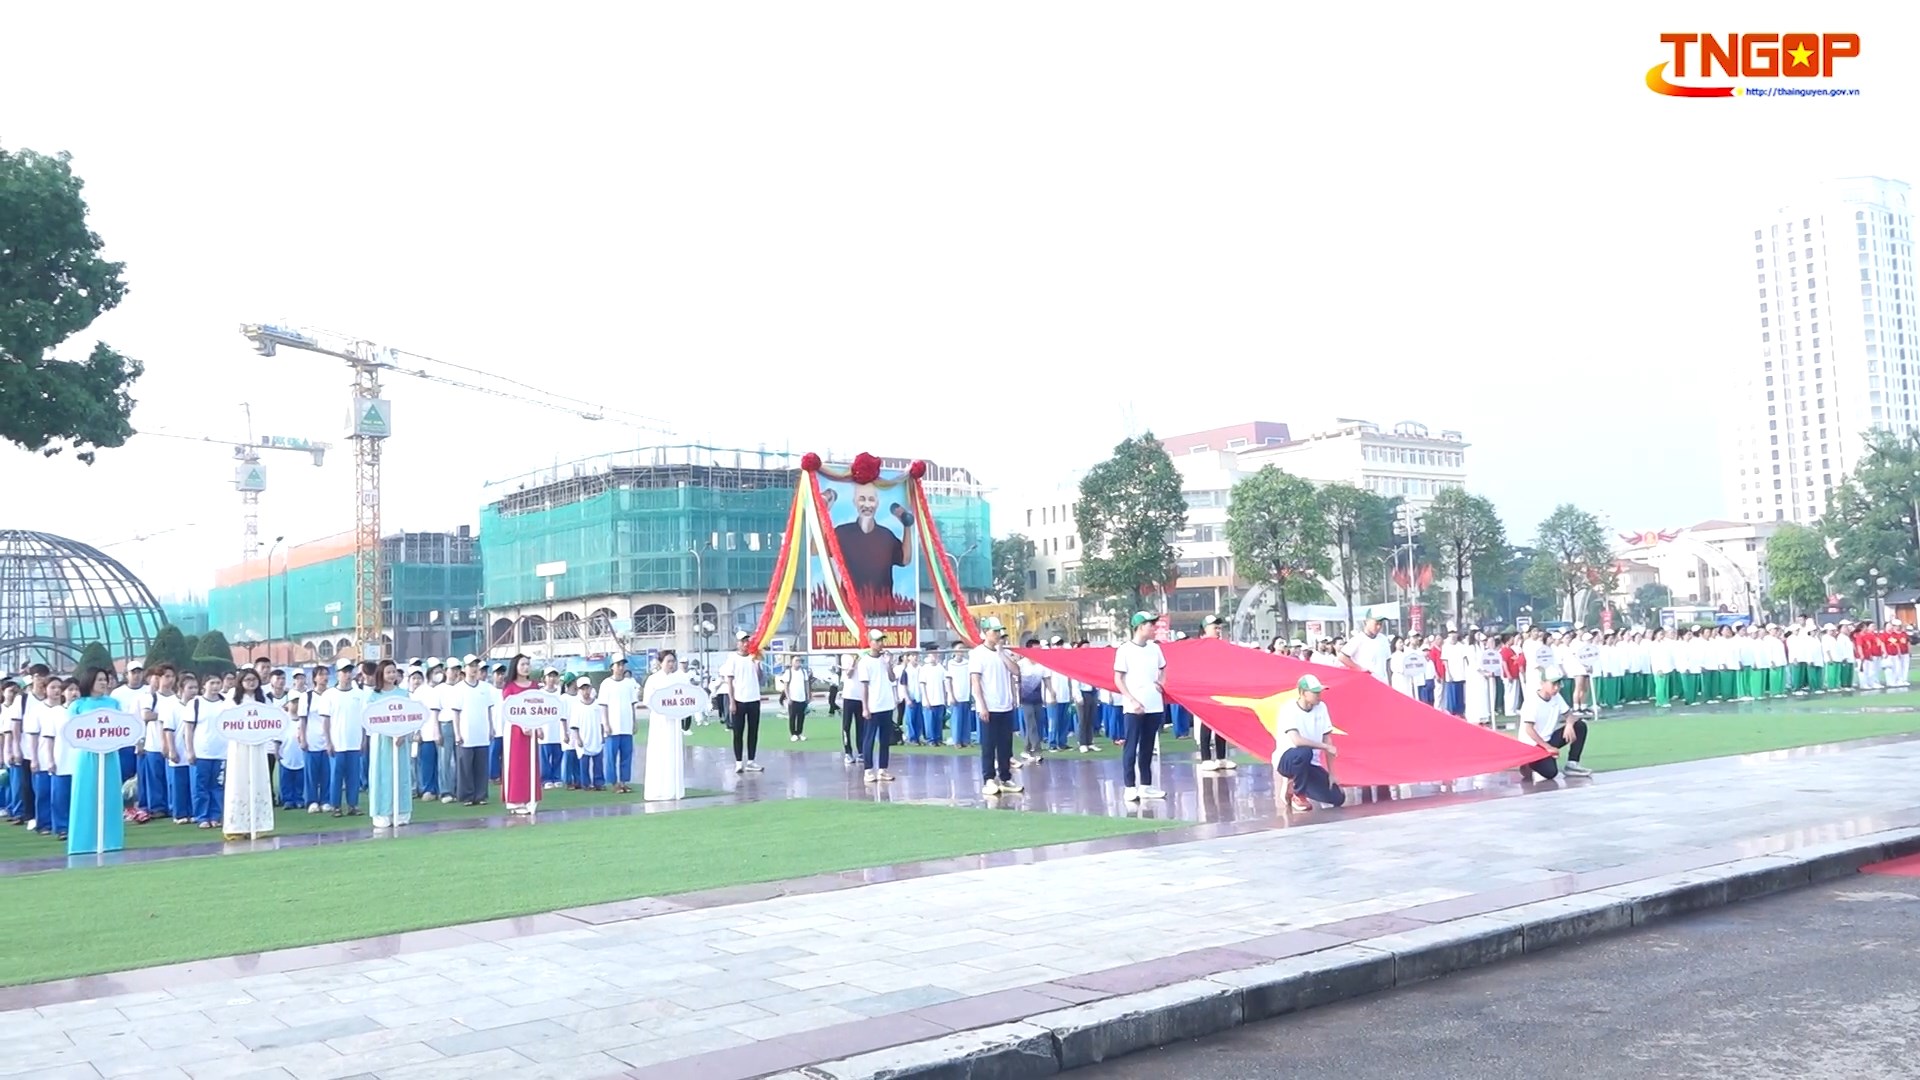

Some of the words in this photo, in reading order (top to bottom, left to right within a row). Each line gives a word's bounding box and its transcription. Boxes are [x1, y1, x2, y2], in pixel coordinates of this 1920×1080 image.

[388, 703, 403, 711] CLB
[510, 706, 527, 716] GIA
[76, 728, 96, 742] ĐẠI
[99, 725, 131, 738] PHÚC
